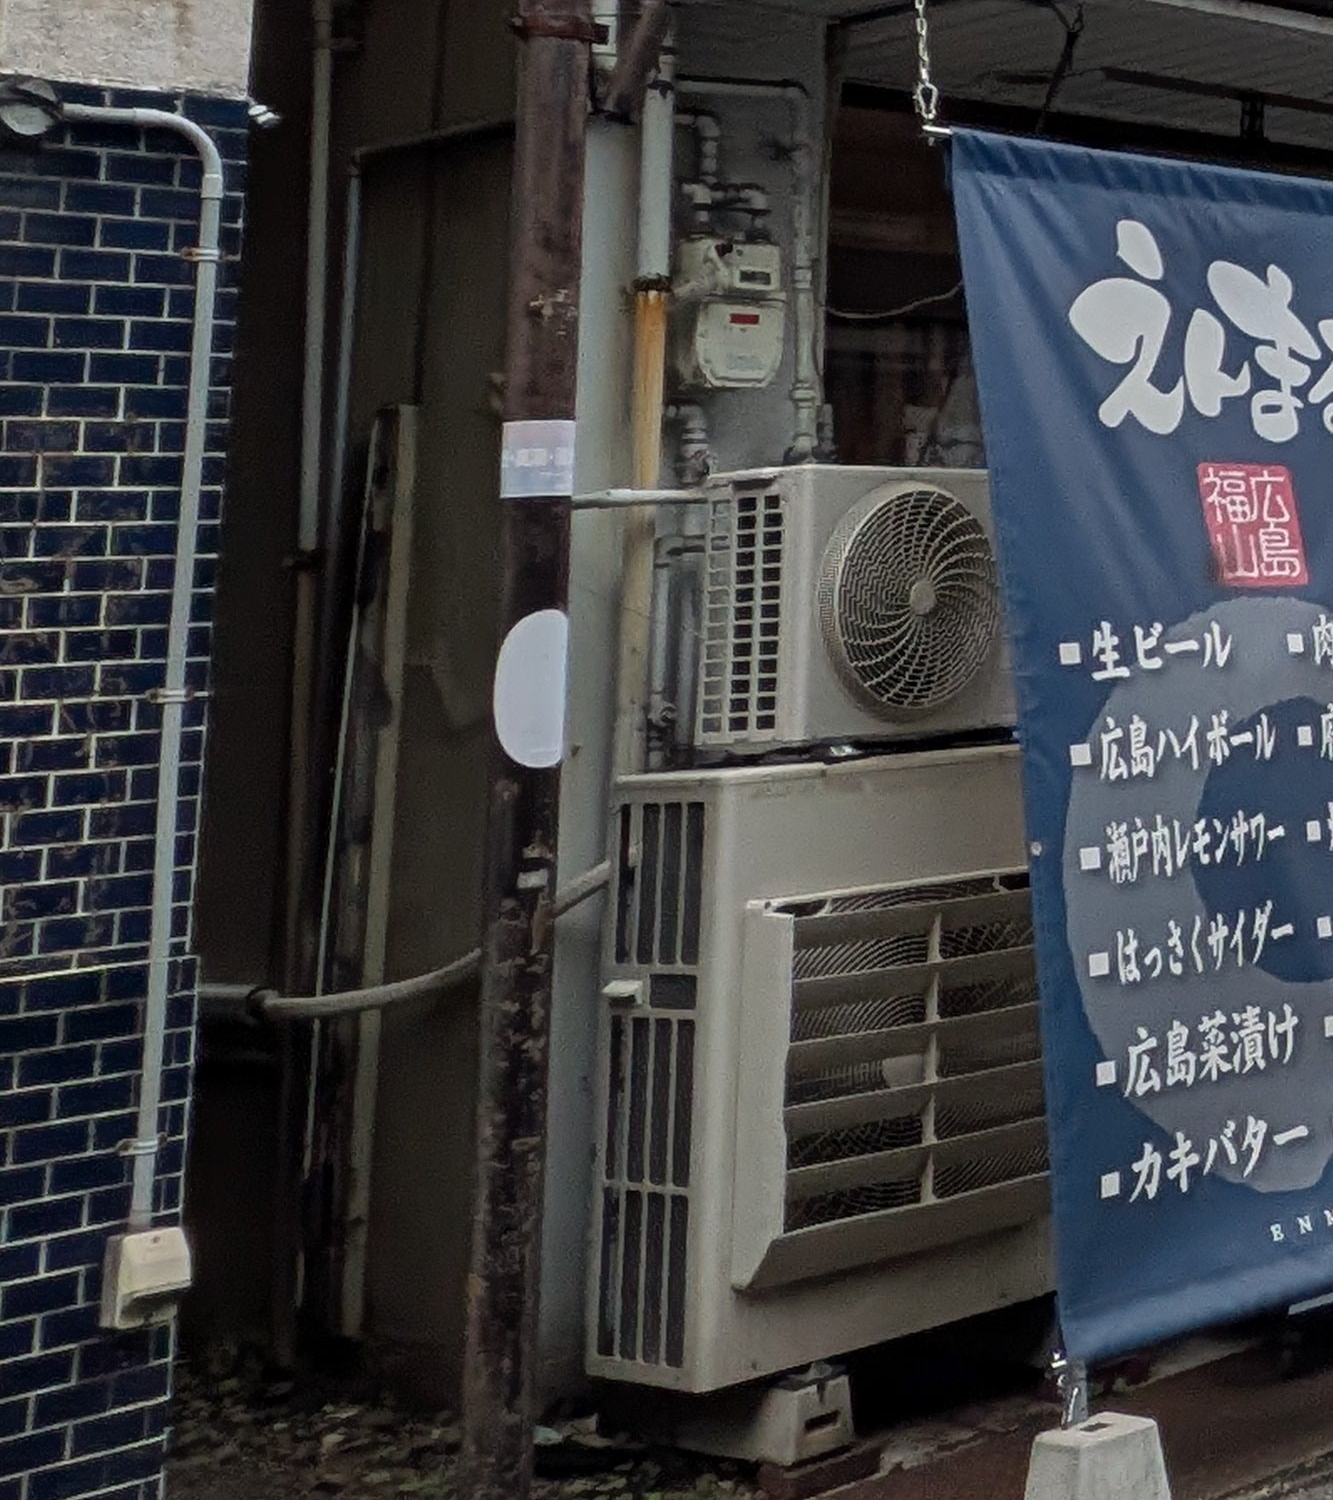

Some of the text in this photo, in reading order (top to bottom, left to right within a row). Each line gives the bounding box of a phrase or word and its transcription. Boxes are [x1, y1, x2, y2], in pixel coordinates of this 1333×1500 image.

[1090, 621, 1232, 682] 生ビール
[1100, 708, 1276, 781] 広島ハイボール
[1106, 811, 1286, 885] 瀬戸内レモンサワー
[1116, 901, 1295, 986] はっさくサイダー
[1124, 1004, 1300, 1099] 広島菜漬け
[1129, 1116, 1309, 1204] カキバター
